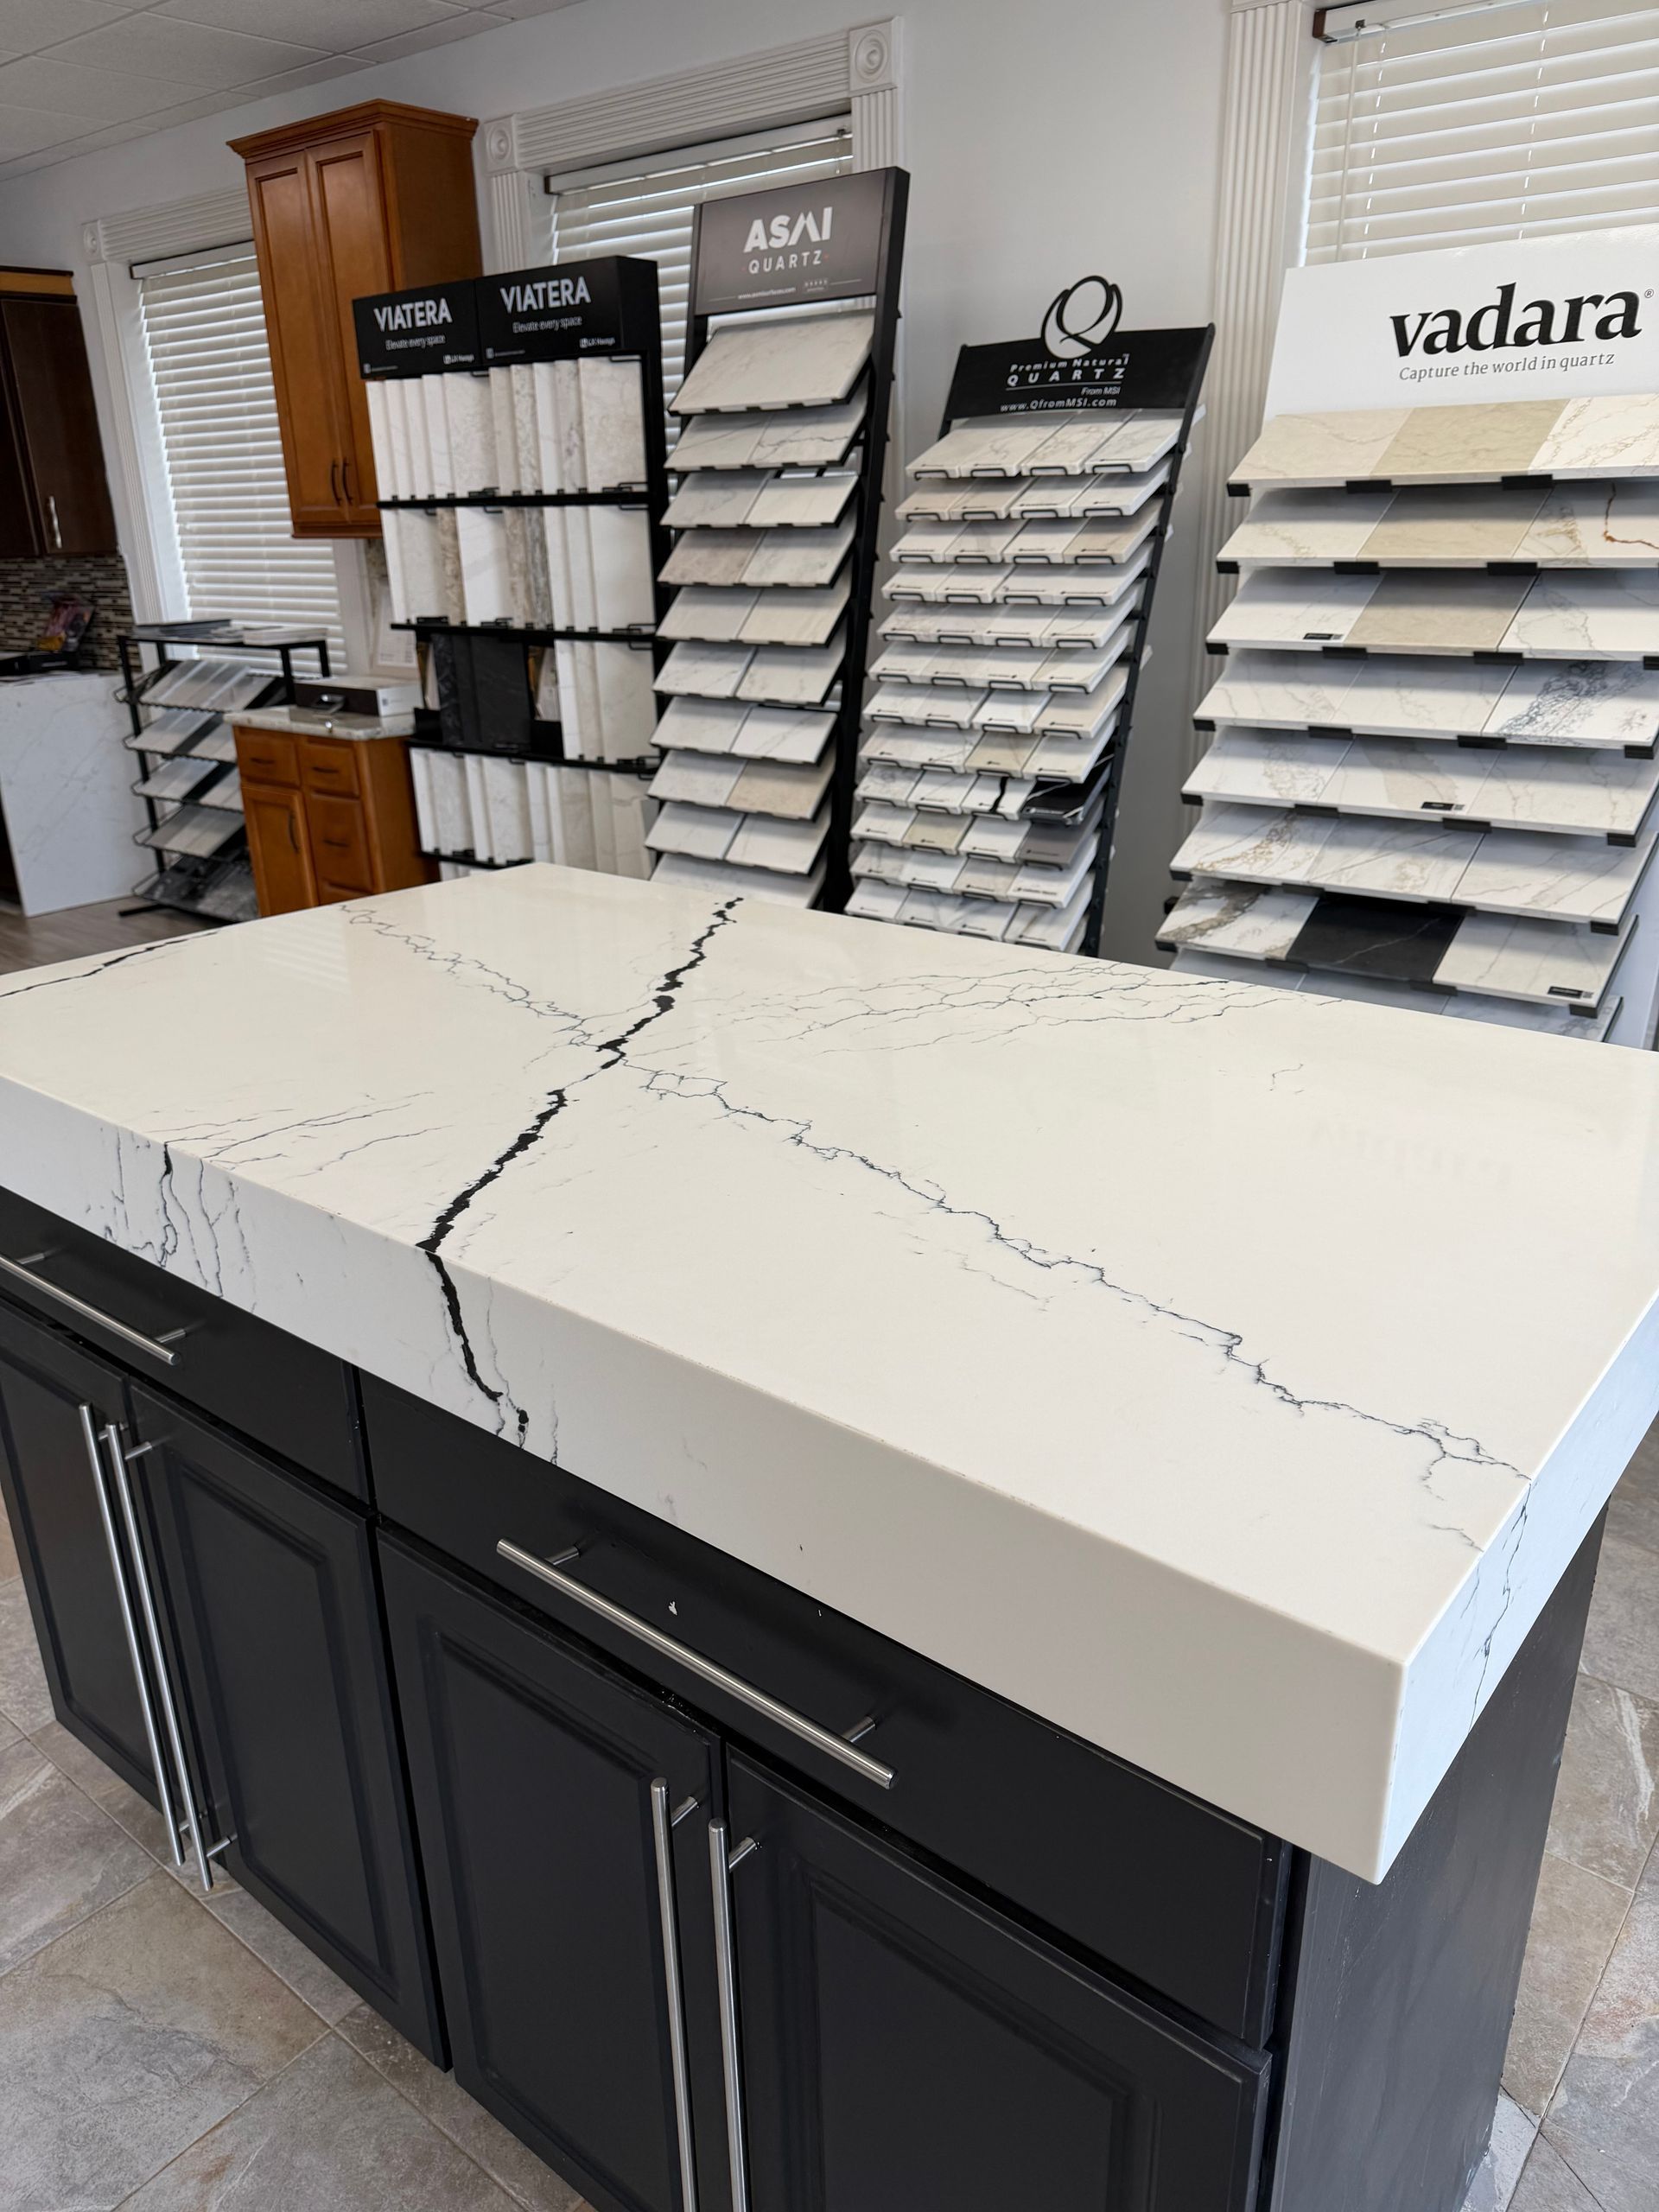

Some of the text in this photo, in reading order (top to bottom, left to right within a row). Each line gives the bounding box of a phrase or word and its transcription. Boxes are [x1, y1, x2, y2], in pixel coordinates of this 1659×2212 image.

[748, 250, 822, 274] QUARTZ
[499, 276, 592, 314] VIATERA
[373, 297, 453, 332] VIATERA
[1007, 368, 1125, 387] QUARTZ
[1010, 360, 1068, 372] Premium
[1399, 353, 1615, 382] Capture the world in quartz
[1000, 398, 1117, 412] www.QfromMSI.com
